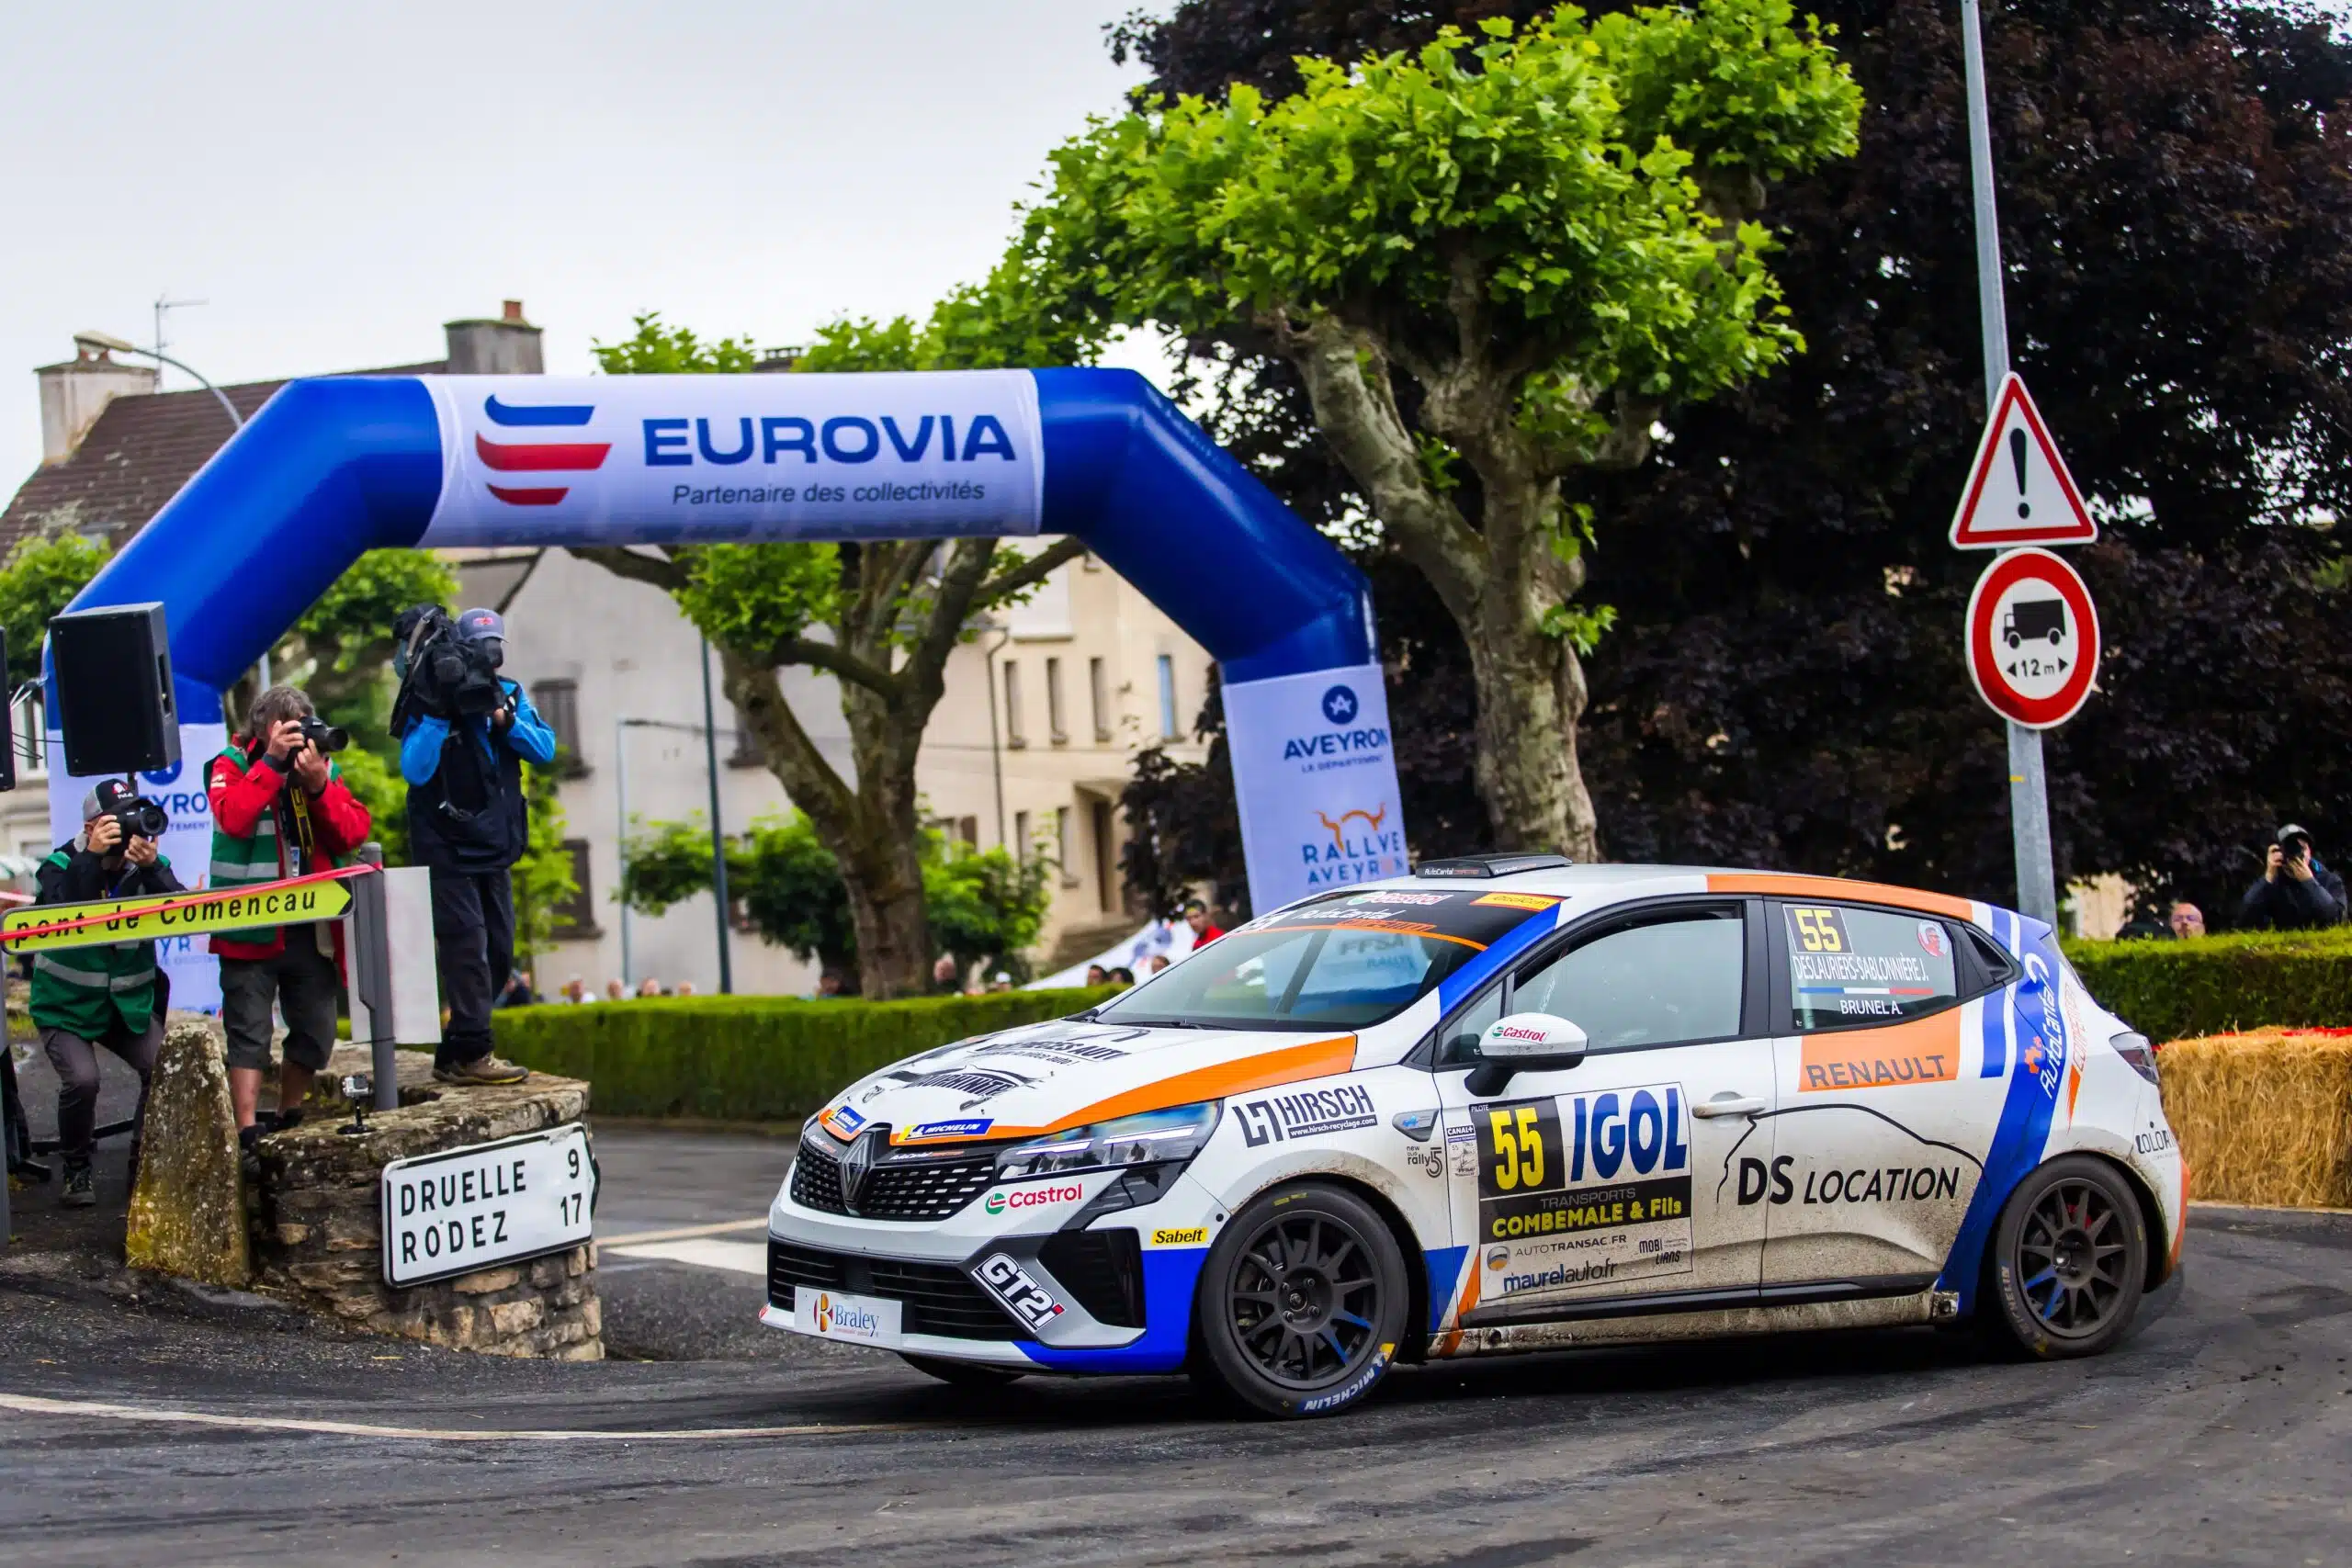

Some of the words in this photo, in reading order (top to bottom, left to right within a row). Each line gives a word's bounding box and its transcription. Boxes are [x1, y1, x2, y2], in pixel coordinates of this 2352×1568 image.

[643, 414, 1017, 467] EUROVIA
[673, 484, 797, 505] Partenaire
[803, 483, 846, 503] des
[853, 479, 986, 502] collectivités
[2021, 659, 2041, 677] 12
[2044, 664, 2055, 675] m
[1284, 728, 1389, 761] AVEYRON
[106, 906, 140, 931] de
[160, 888, 317, 925] Comencau
[1793, 908, 1842, 952] 55
[1839, 999, 1886, 1015] BRUNEL
[1891, 1000, 1903, 1015] A.
[1503, 1026, 1546, 1043] Castrol
[1805, 1054, 1945, 1089] RENAULT
[1279, 1084, 1375, 1126] HIRSCH
[1471, 1104, 1489, 1112] PILOTE
[924, 1123, 981, 1134] MICHELIN
[1289, 1117, 1376, 1137] www.hirsch-recyclage.com
[1447, 1125, 1475, 1136] CANAL+
[1570, 1087, 1688, 1183] IGOL
[1489, 1107, 1545, 1190] 55
[401, 1159, 527, 1216] DRUELLE
[567, 1148, 580, 1179] 9
[1009, 1182, 1082, 1210] Castrol
[1737, 1155, 1795, 1206] DS
[1803, 1167, 1960, 1205] LOCATION
[1540, 1187, 1636, 1211] TRANSPORTS
[401, 1210, 508, 1264] RODEZ
[560, 1192, 582, 1227] 17
[1492, 1201, 1623, 1238] COMBEMALE
[1630, 1201, 1645, 1219] &
[1650, 1196, 1682, 1218] Fils
[1155, 1228, 1204, 1244] Sabelt
[1639, 1238, 1663, 1254] MOBI
[1504, 1256, 1619, 1292] maurelauto.fr
[980, 1255, 1065, 1333] GT2i
[835, 1304, 879, 1337] Braley
[1304, 1368, 1375, 1412] MICHELIN
